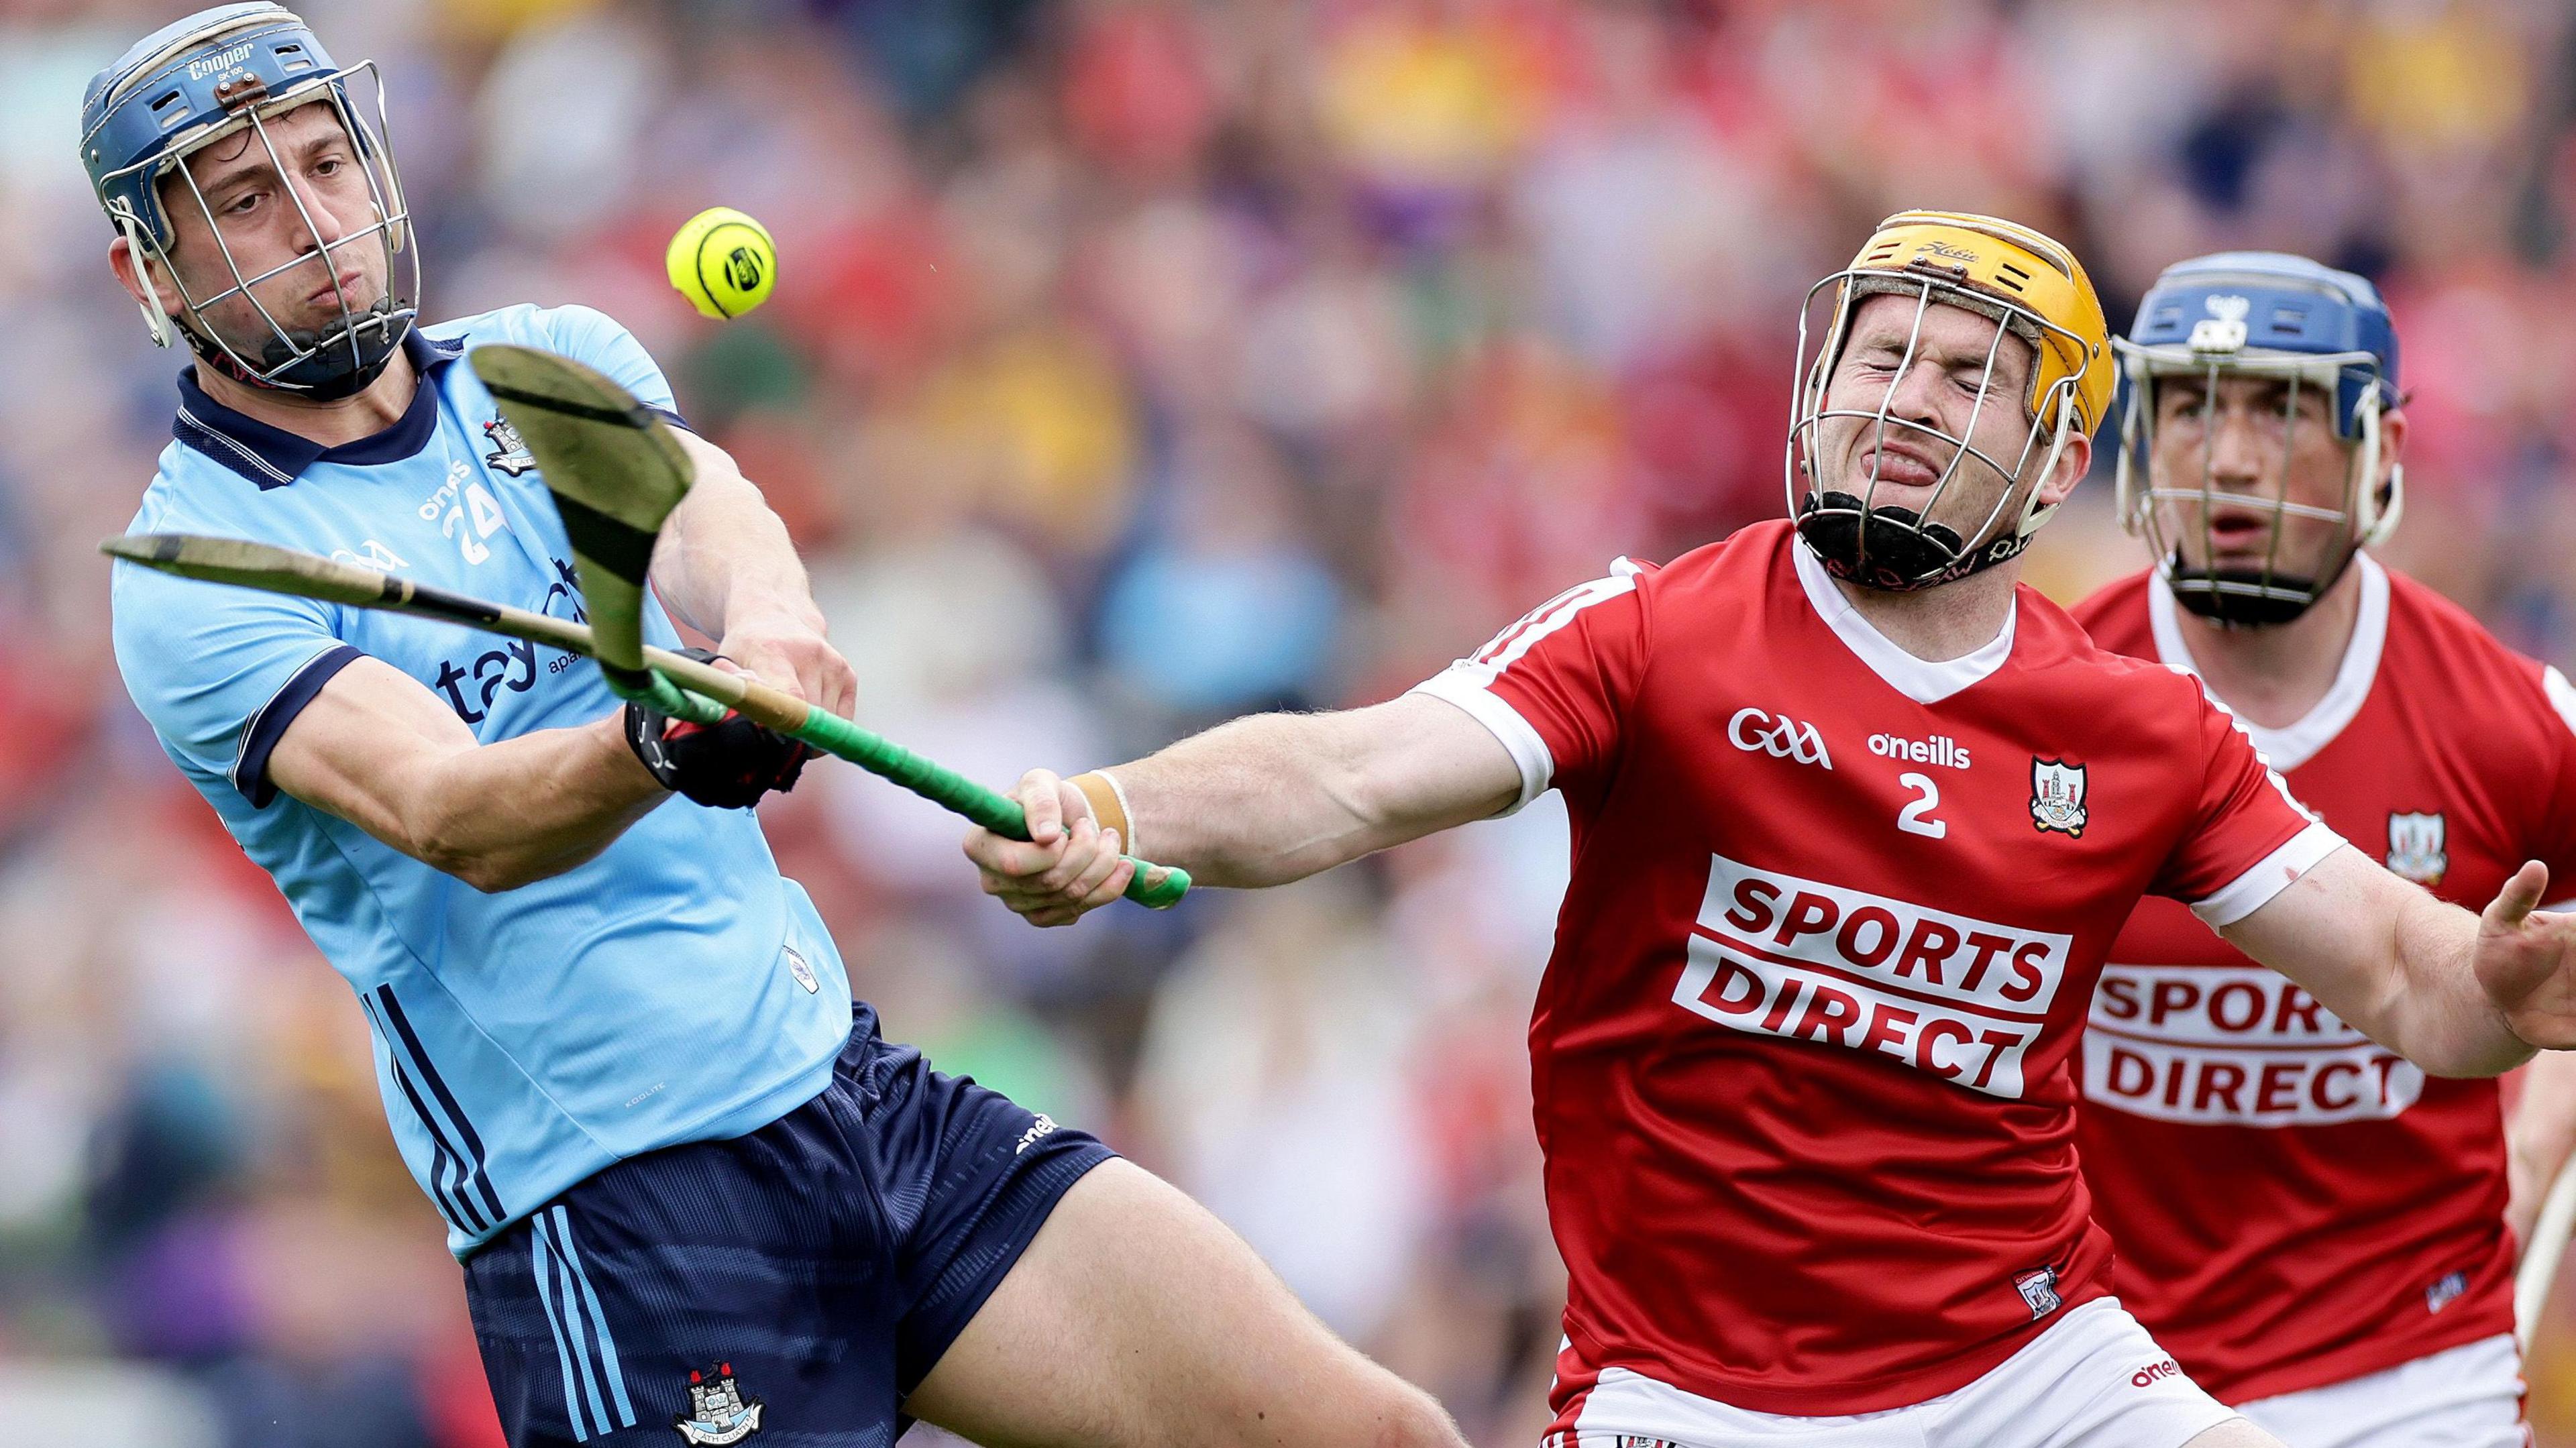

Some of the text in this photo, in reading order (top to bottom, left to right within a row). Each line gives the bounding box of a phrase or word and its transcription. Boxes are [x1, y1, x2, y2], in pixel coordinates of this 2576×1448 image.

[189, 43, 254, 80] Cooper
[217, 71, 230, 81] SK
[443, 482, 515, 565] 24
[1727, 707, 1833, 771] GAA
[1867, 732, 1971, 770] o'neills
[1898, 771, 1946, 839] 2
[1724, 878, 2051, 1003] SPORTS
[1698, 957, 2025, 1089] DIRECT
[2101, 978, 2353, 1034] SPOR
[625, 1081, 666, 1109] KOOLITE
[2106, 1045, 2404, 1115] DIRECT
